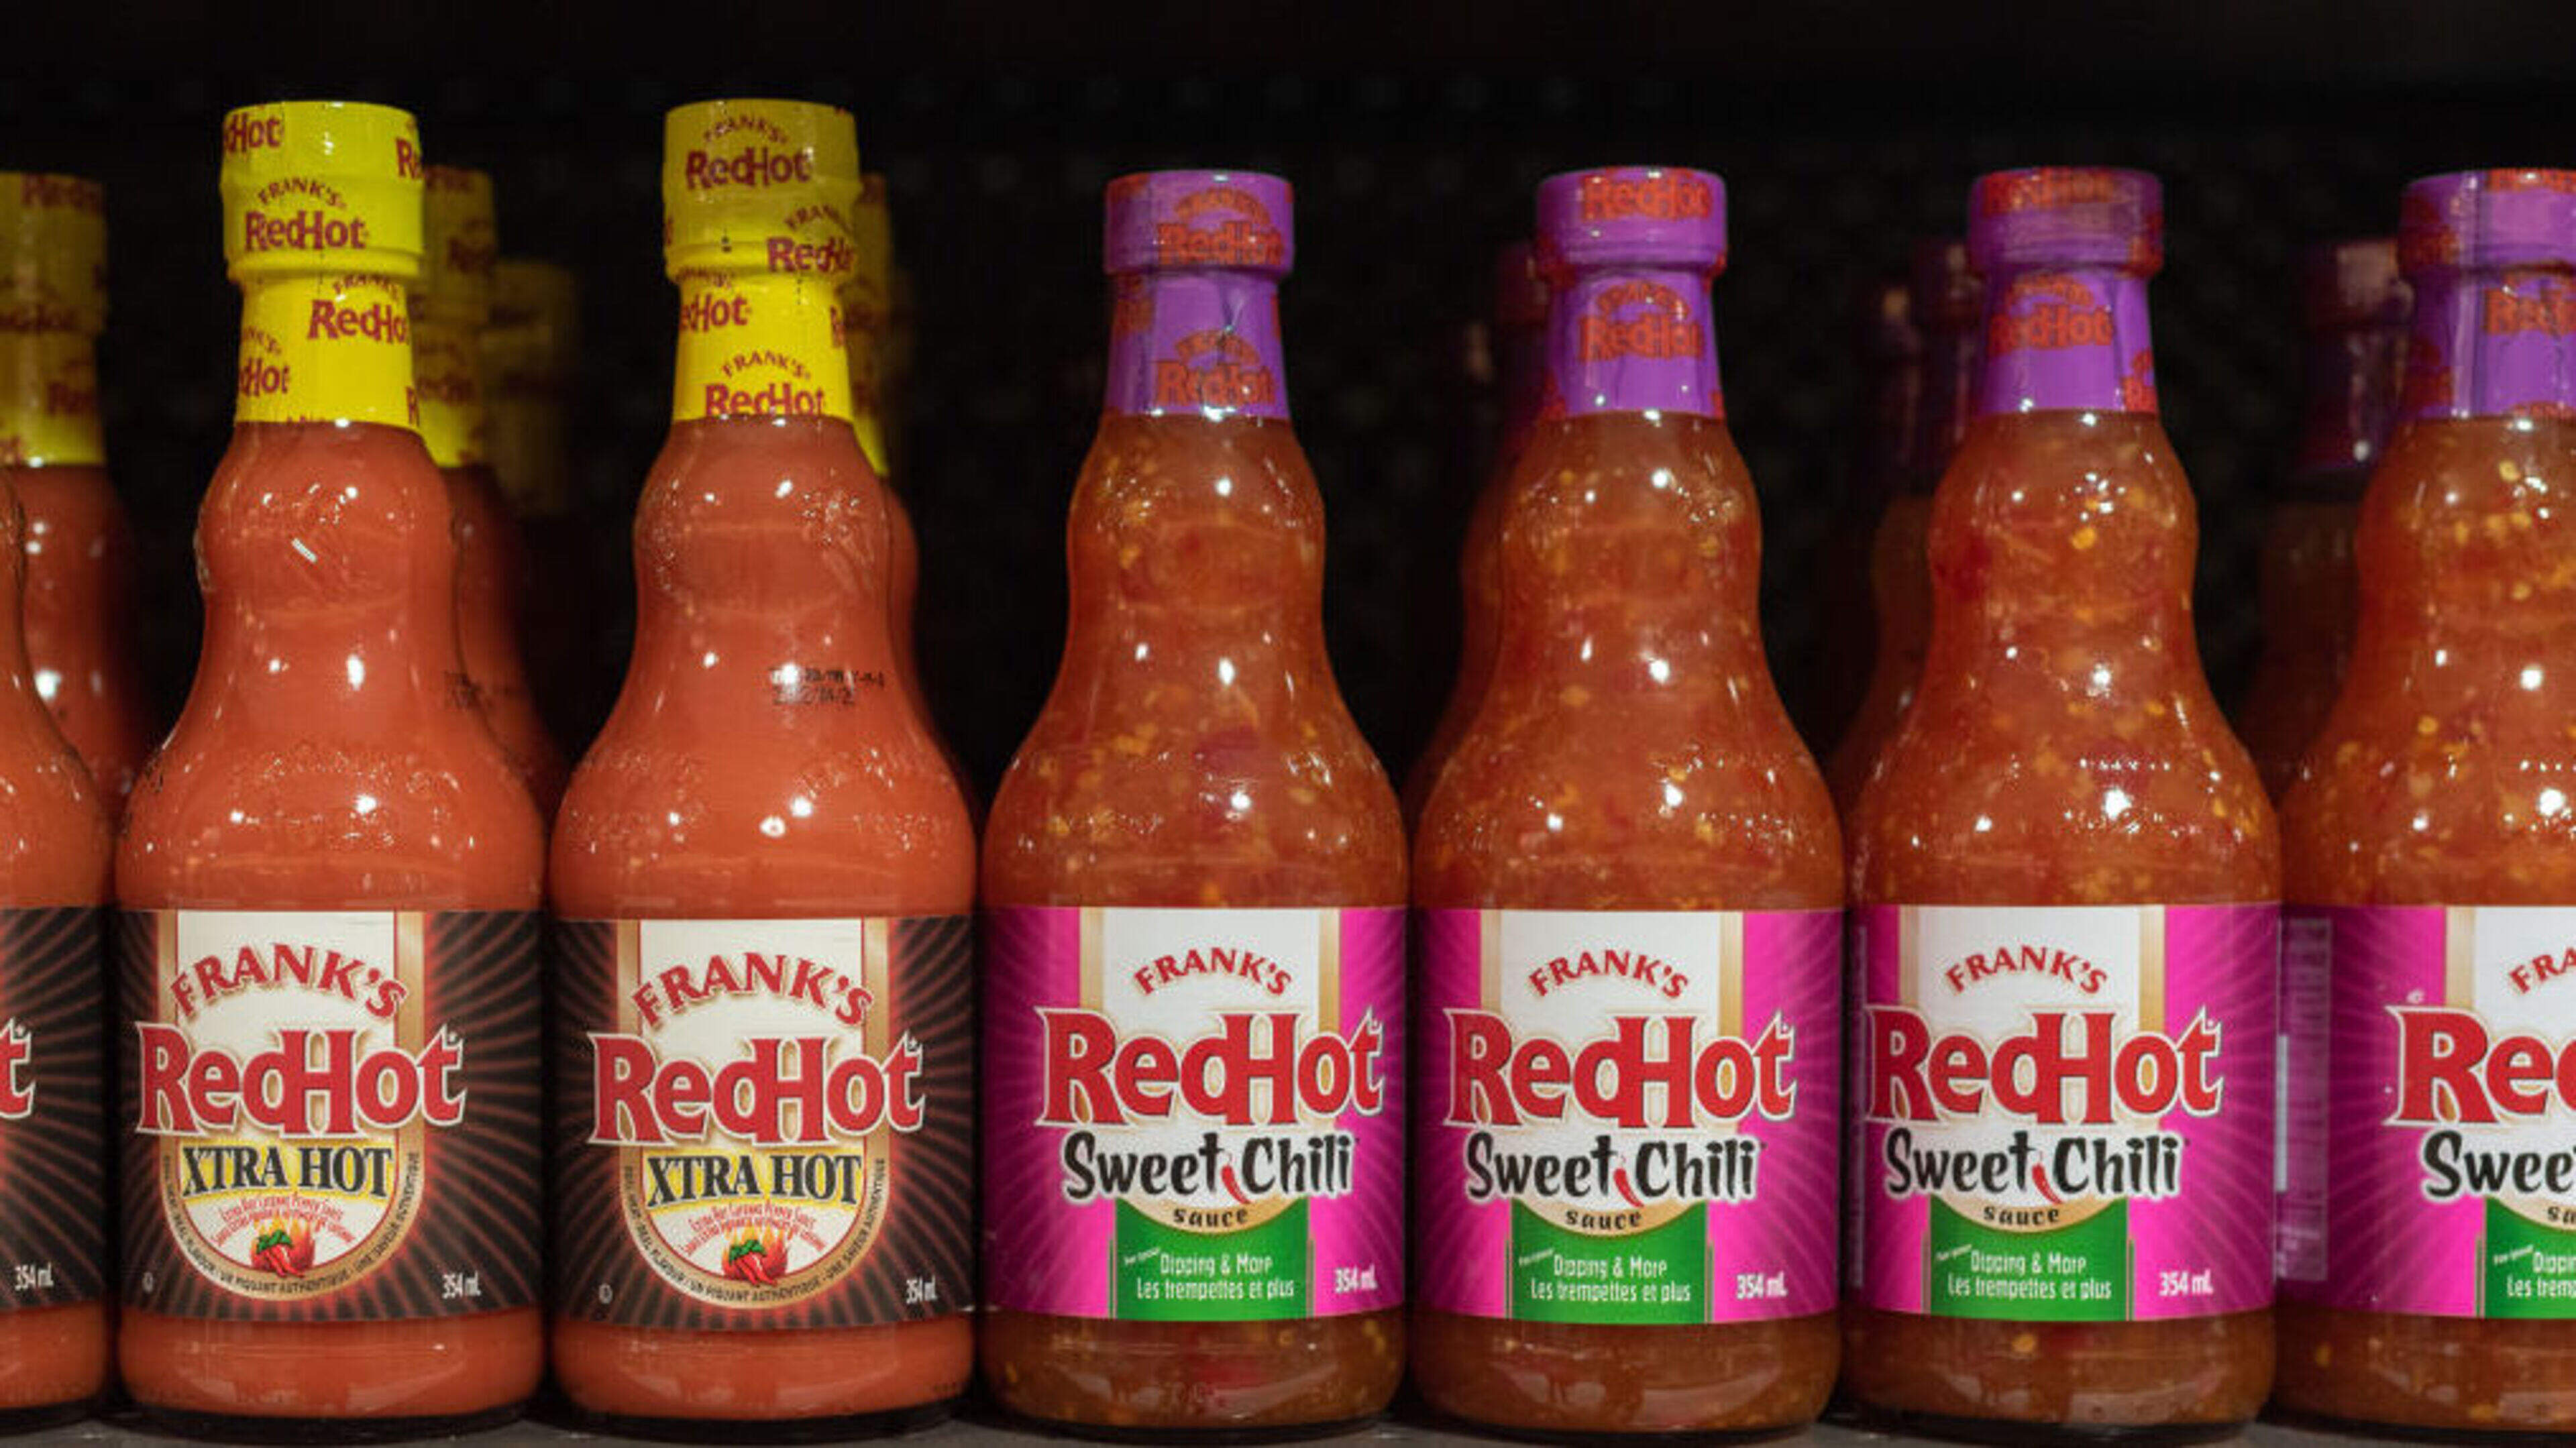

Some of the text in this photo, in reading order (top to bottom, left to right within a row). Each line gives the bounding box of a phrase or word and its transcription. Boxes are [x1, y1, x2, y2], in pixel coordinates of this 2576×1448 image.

[258, 177, 341, 206] FRANK'S
[686, 146, 812, 190] RedHot
[245, 210, 366, 252] RedHot
[307, 299, 407, 345] RedHo
[722, 351, 804, 378] FRANK'S
[170, 942, 407, 1020] FRANK'S
[632, 952, 872, 1027] FRANK'S
[1133, 947, 1291, 997] FRANK'S
[1527, 950, 1688, 999] FRANK'S
[1945, 945, 2108, 995] FRANK'S
[2508, 948, 2576, 995] FRA
[137, 1021, 466, 1138] RedHot
[588, 1030, 925, 1147] RedHot
[1034, 1006, 1385, 1127] RedHot
[1443, 1008, 1797, 1130] RedHot
[1864, 1005, 2223, 1126] RedHot
[182, 1146, 288, 1197] XTRA
[297, 1146, 392, 1197] HOT
[647, 1154, 861, 1207] XTRA HOT
[1064, 1131, 1352, 1200] Sweet Chili
[1467, 1132, 1754, 1199] Sweet Chili
[1886, 1127, 2180, 1195] Sweet Chili
[2423, 1130, 2576, 1198] Swee
[1173, 1207, 1248, 1229] sauce
[1565, 1210, 1642, 1231] sauce
[1984, 1206, 2060, 1225] sauce
[1221, 1252, 1230, 1274] &
[1236, 1251, 1273, 1274] More
[1613, 1256, 1623, 1278] &
[1630, 1256, 1667, 1278] More
[1736, 1273, 1762, 1299] 354
[2032, 1251, 2042, 1274] &
[2048, 1251, 2086, 1274] More
[2160, 1272, 2188, 1296] 354
[1137, 1277, 1160, 1300] Les
[1249, 1279, 1263, 1299] et
[1267, 1277, 1294, 1300] plus
[1532, 1278, 1553, 1300] Les
[1643, 1282, 1657, 1301] et
[1661, 1280, 1691, 1304] plus
[1948, 1273, 1971, 1296] Les
[2061, 1279, 2076, 1299] et
[2080, 1277, 2112, 1300] plus
